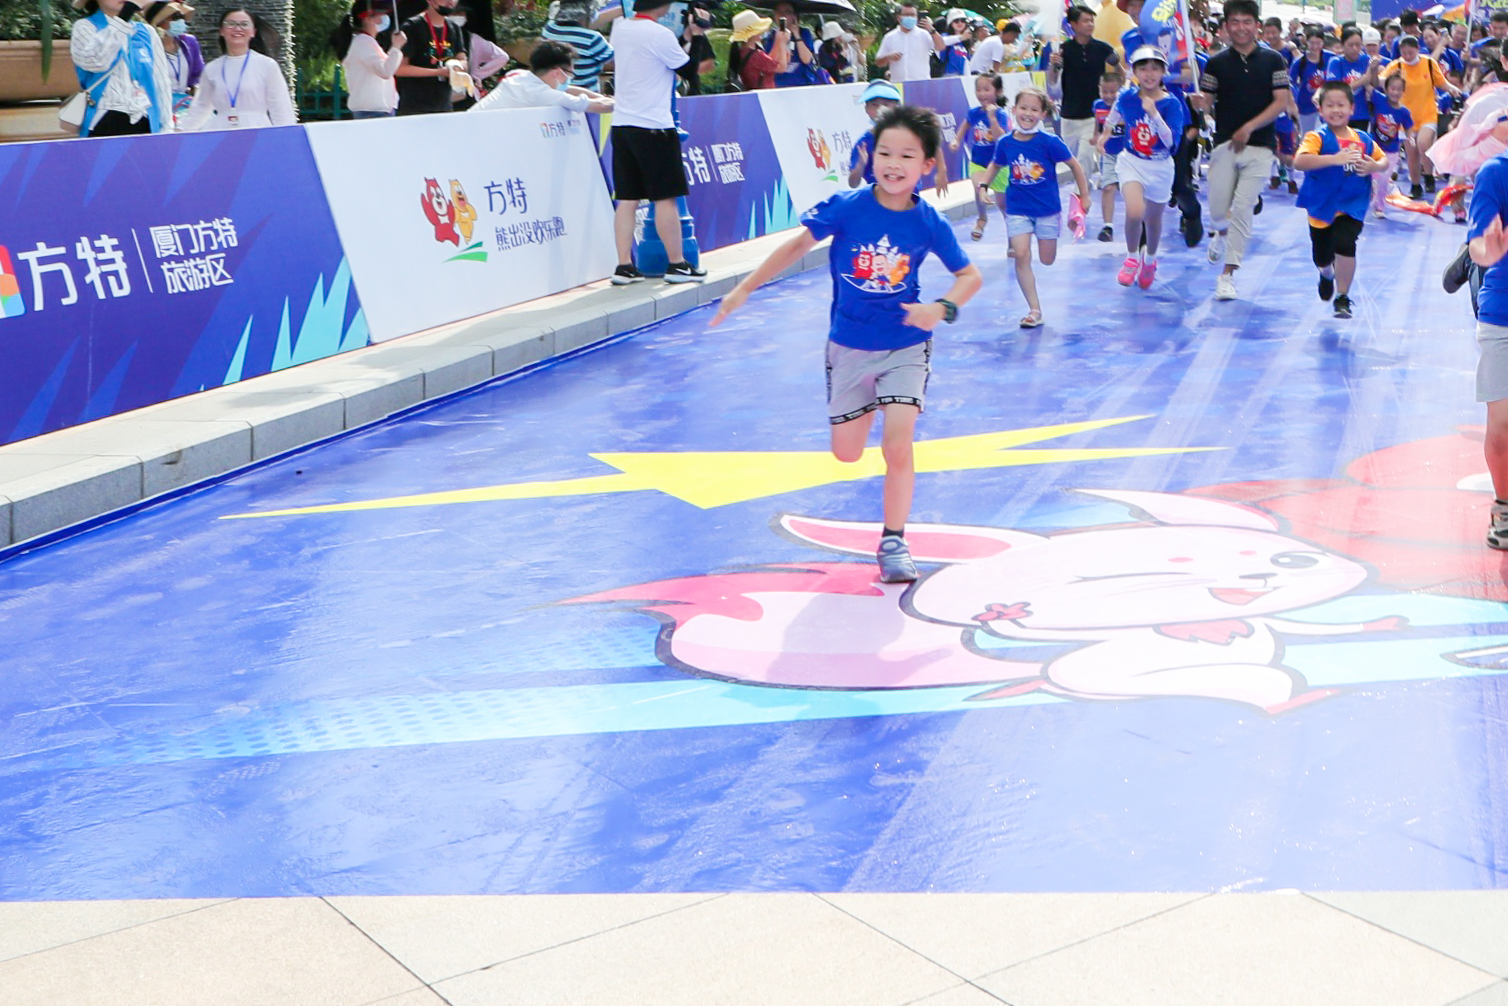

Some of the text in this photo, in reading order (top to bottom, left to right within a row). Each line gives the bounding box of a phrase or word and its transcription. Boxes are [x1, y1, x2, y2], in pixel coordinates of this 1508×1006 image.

[483, 177, 528, 216] 方特
[149, 217, 240, 259] 厦门方特
[495, 215, 568, 253] 熊出没欢乐跑
[17, 234, 133, 312] 方特
[160, 253, 235, 295] 旅游区
